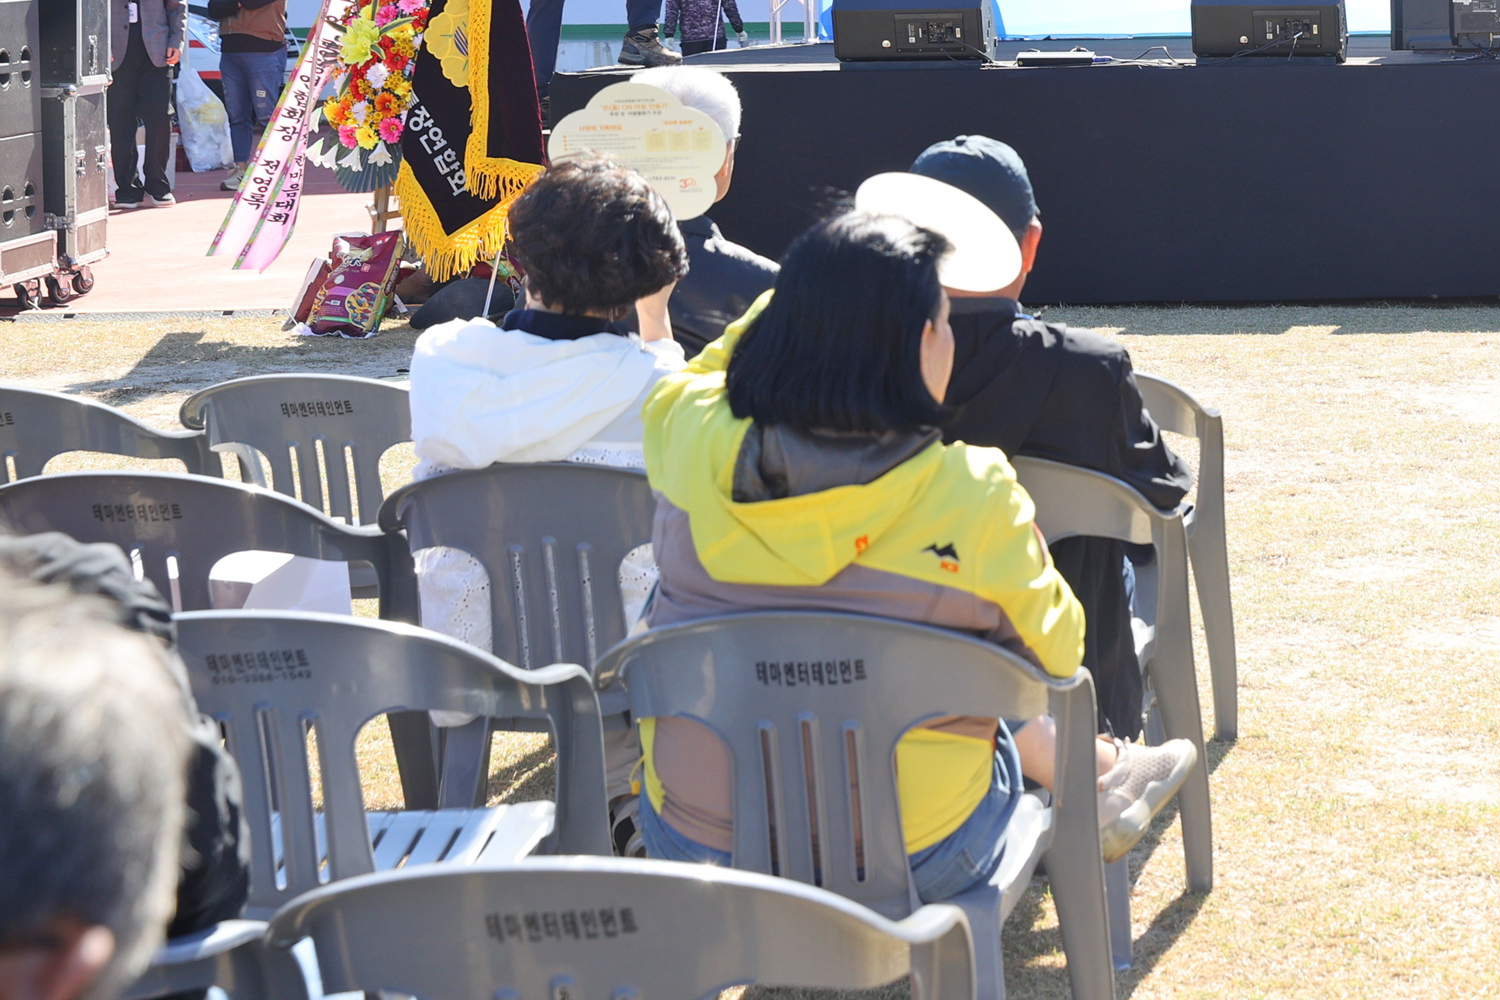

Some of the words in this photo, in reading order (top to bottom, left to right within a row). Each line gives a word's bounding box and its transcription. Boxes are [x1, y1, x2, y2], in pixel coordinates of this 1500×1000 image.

[408, 90, 468, 197] 장연합회
[280, 400, 354, 418] 테마엔터테인먼트
[91, 503, 183, 523] 테마엔터테인먼트
[755, 659, 868, 687] 테마엔터테인먼트
